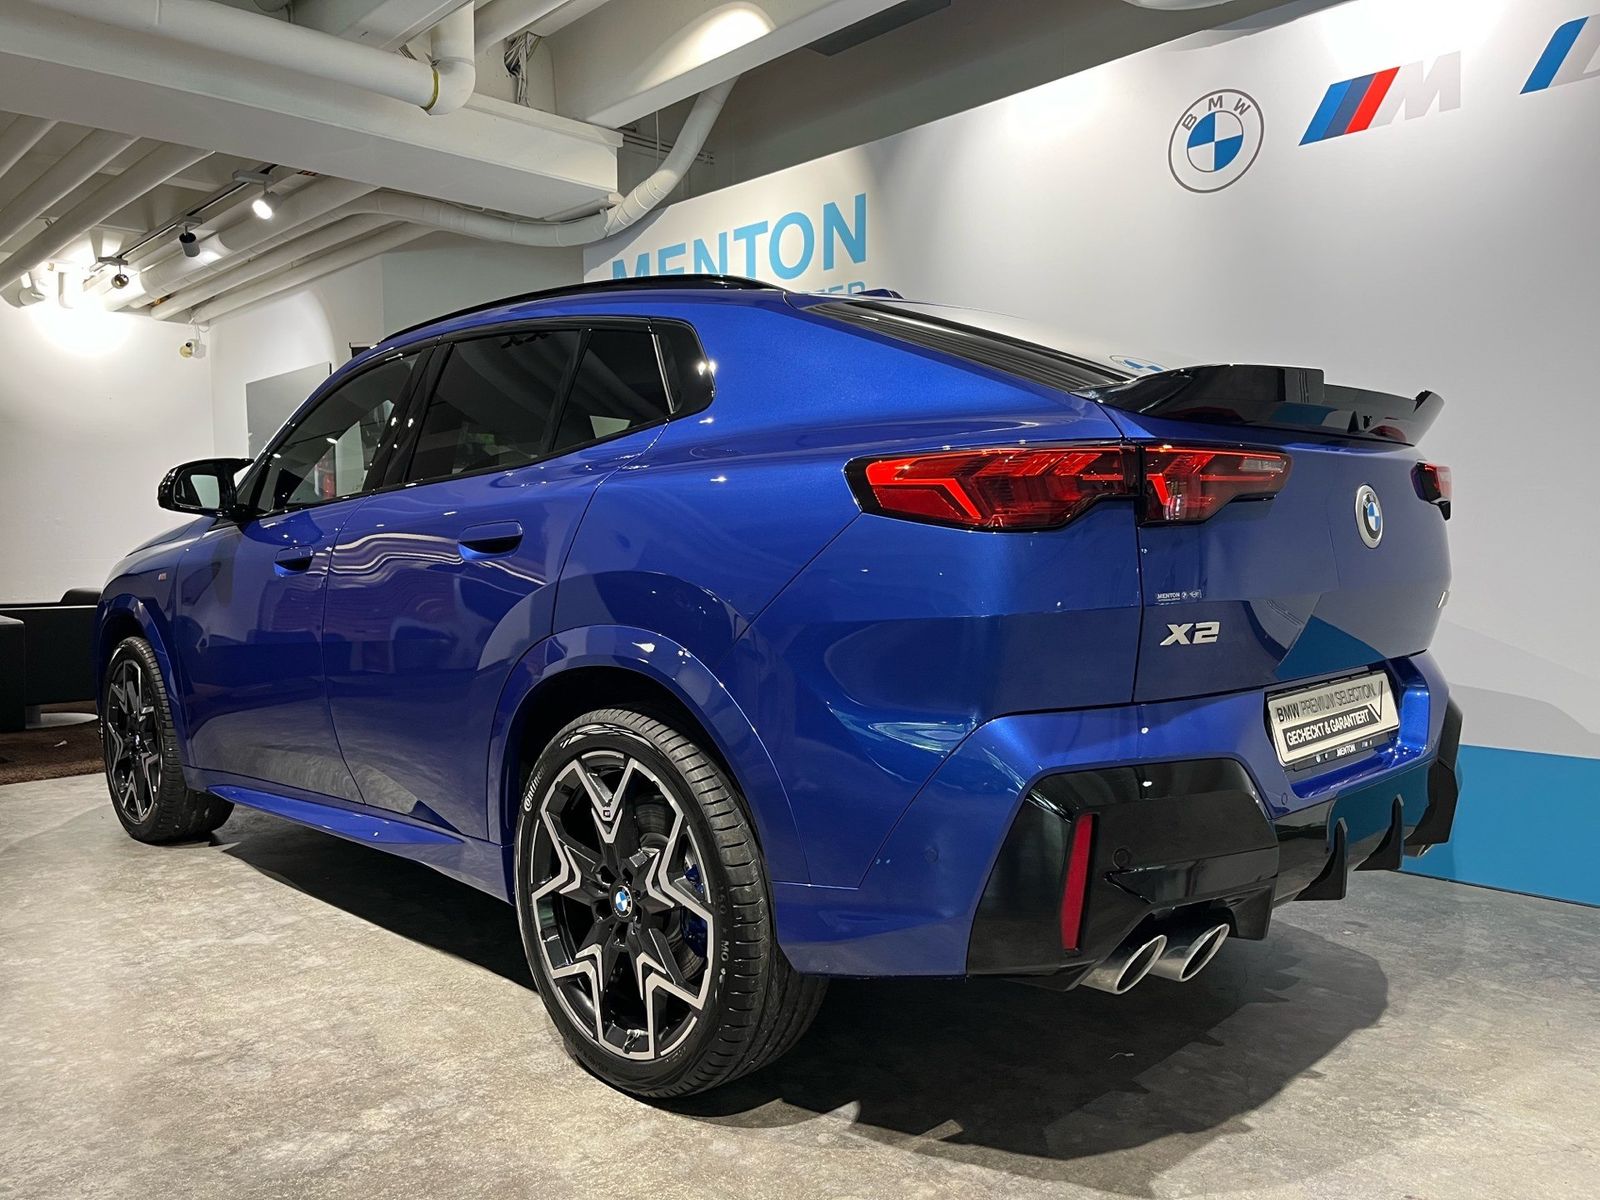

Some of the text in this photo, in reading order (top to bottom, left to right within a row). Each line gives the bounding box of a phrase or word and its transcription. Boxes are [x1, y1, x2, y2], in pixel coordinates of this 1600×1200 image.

[1182, 95, 1251, 131] BMW
[1160, 621, 1220, 646] X2
[1277, 682, 1377, 722] BMW PREMIUM SELECTION
[1286, 709, 1370, 746] GECHECKT & GARANTIERT
[1336, 744, 1356, 757] MENTON
